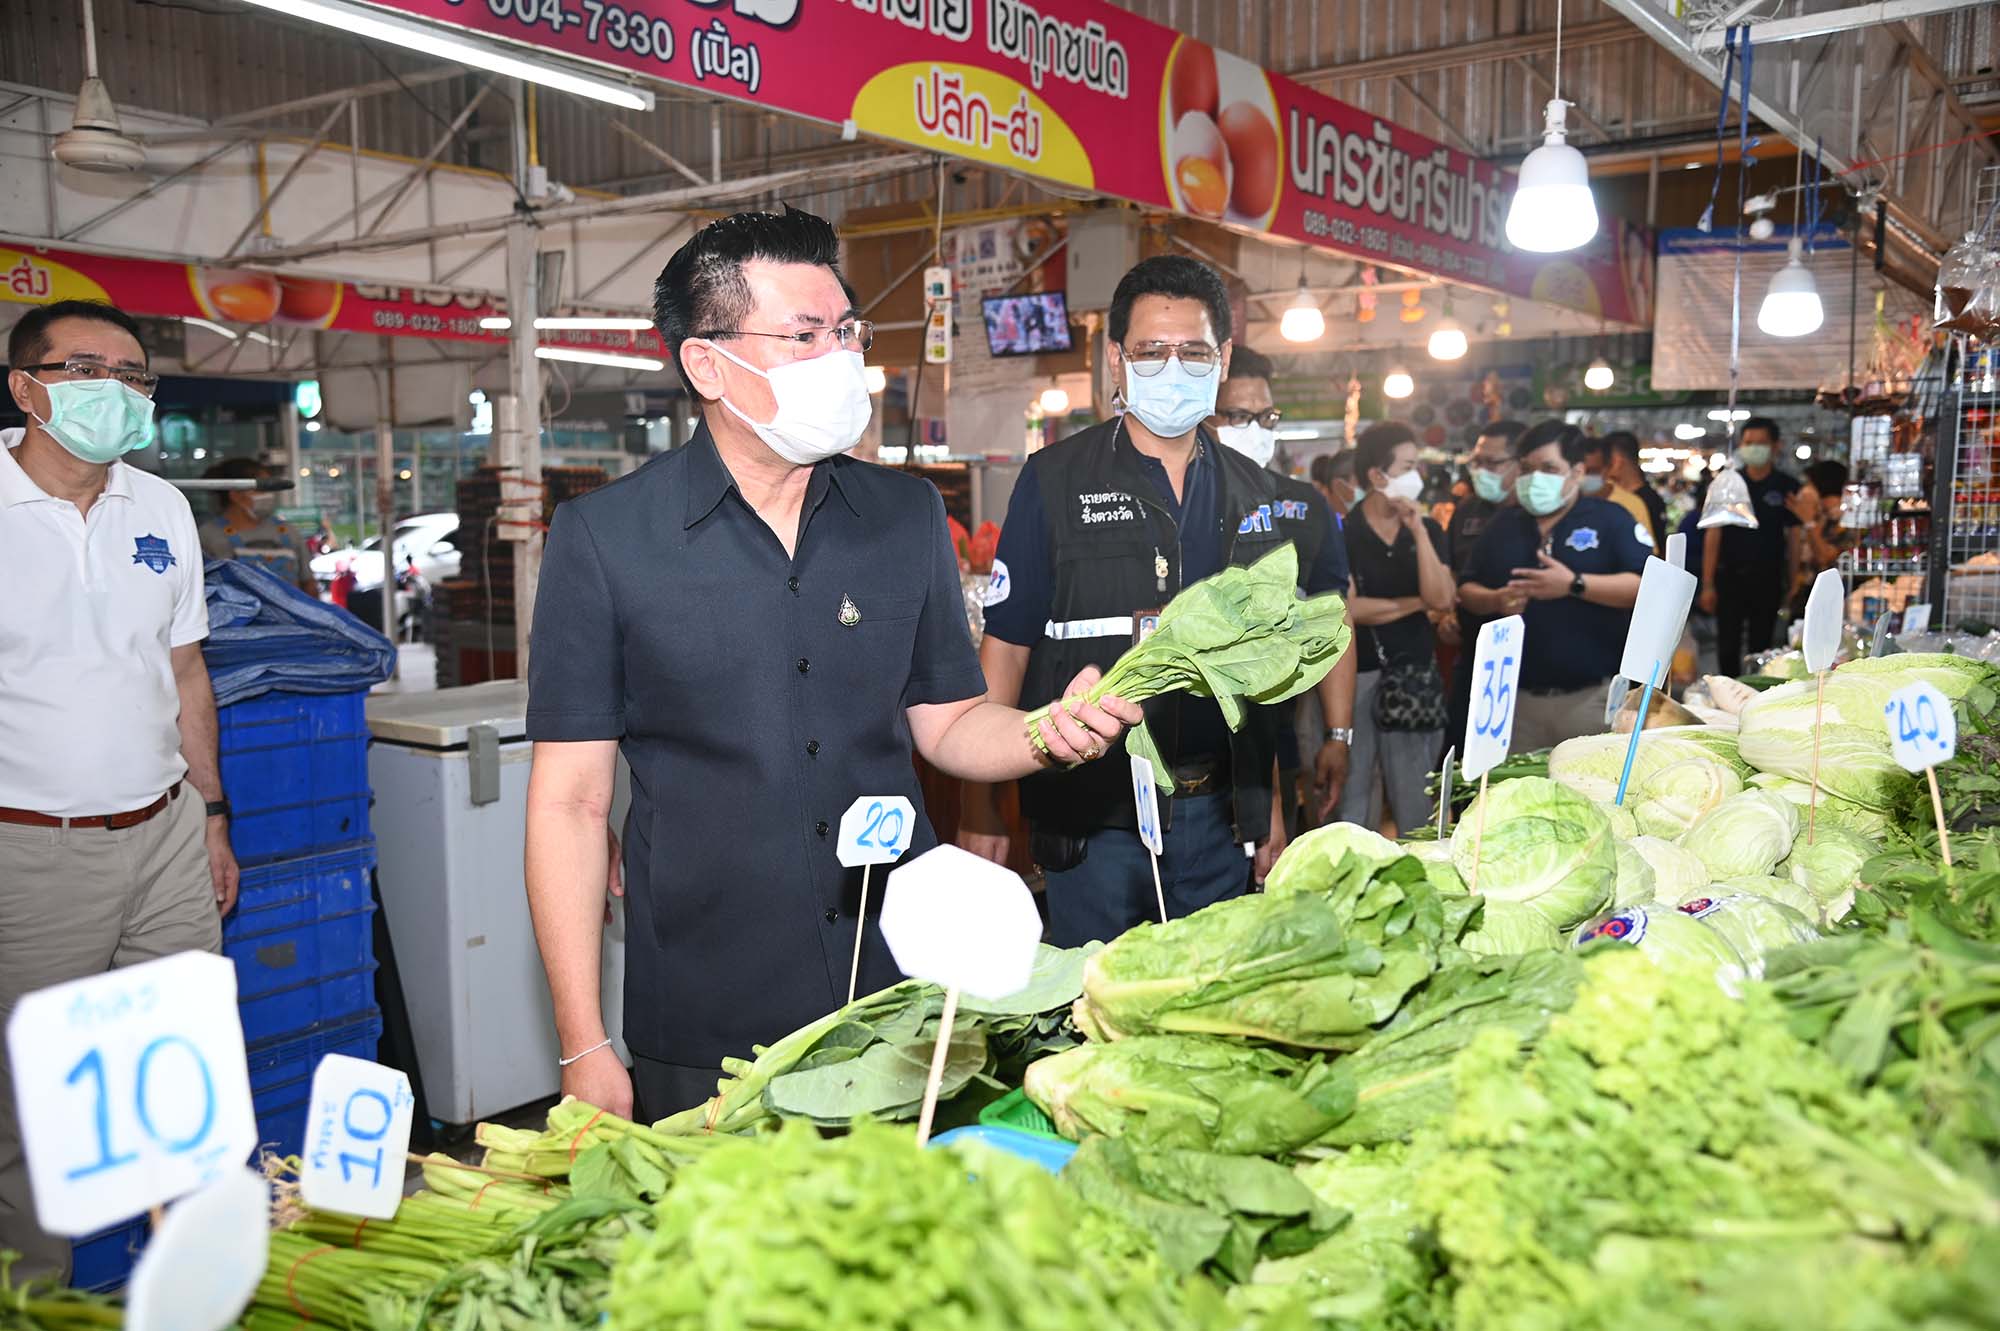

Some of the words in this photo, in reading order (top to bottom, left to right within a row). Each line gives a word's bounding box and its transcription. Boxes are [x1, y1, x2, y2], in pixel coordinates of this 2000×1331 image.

[913, 66, 1042, 163] ปลีก-ส่ง
[1289, 108, 1512, 254] นครชัยศรีฟาร์
[1081, 505, 1134, 523] ชั่งตวงวัด
[65, 1034, 218, 1181] 10
[340, 1086, 393, 1190] 10
